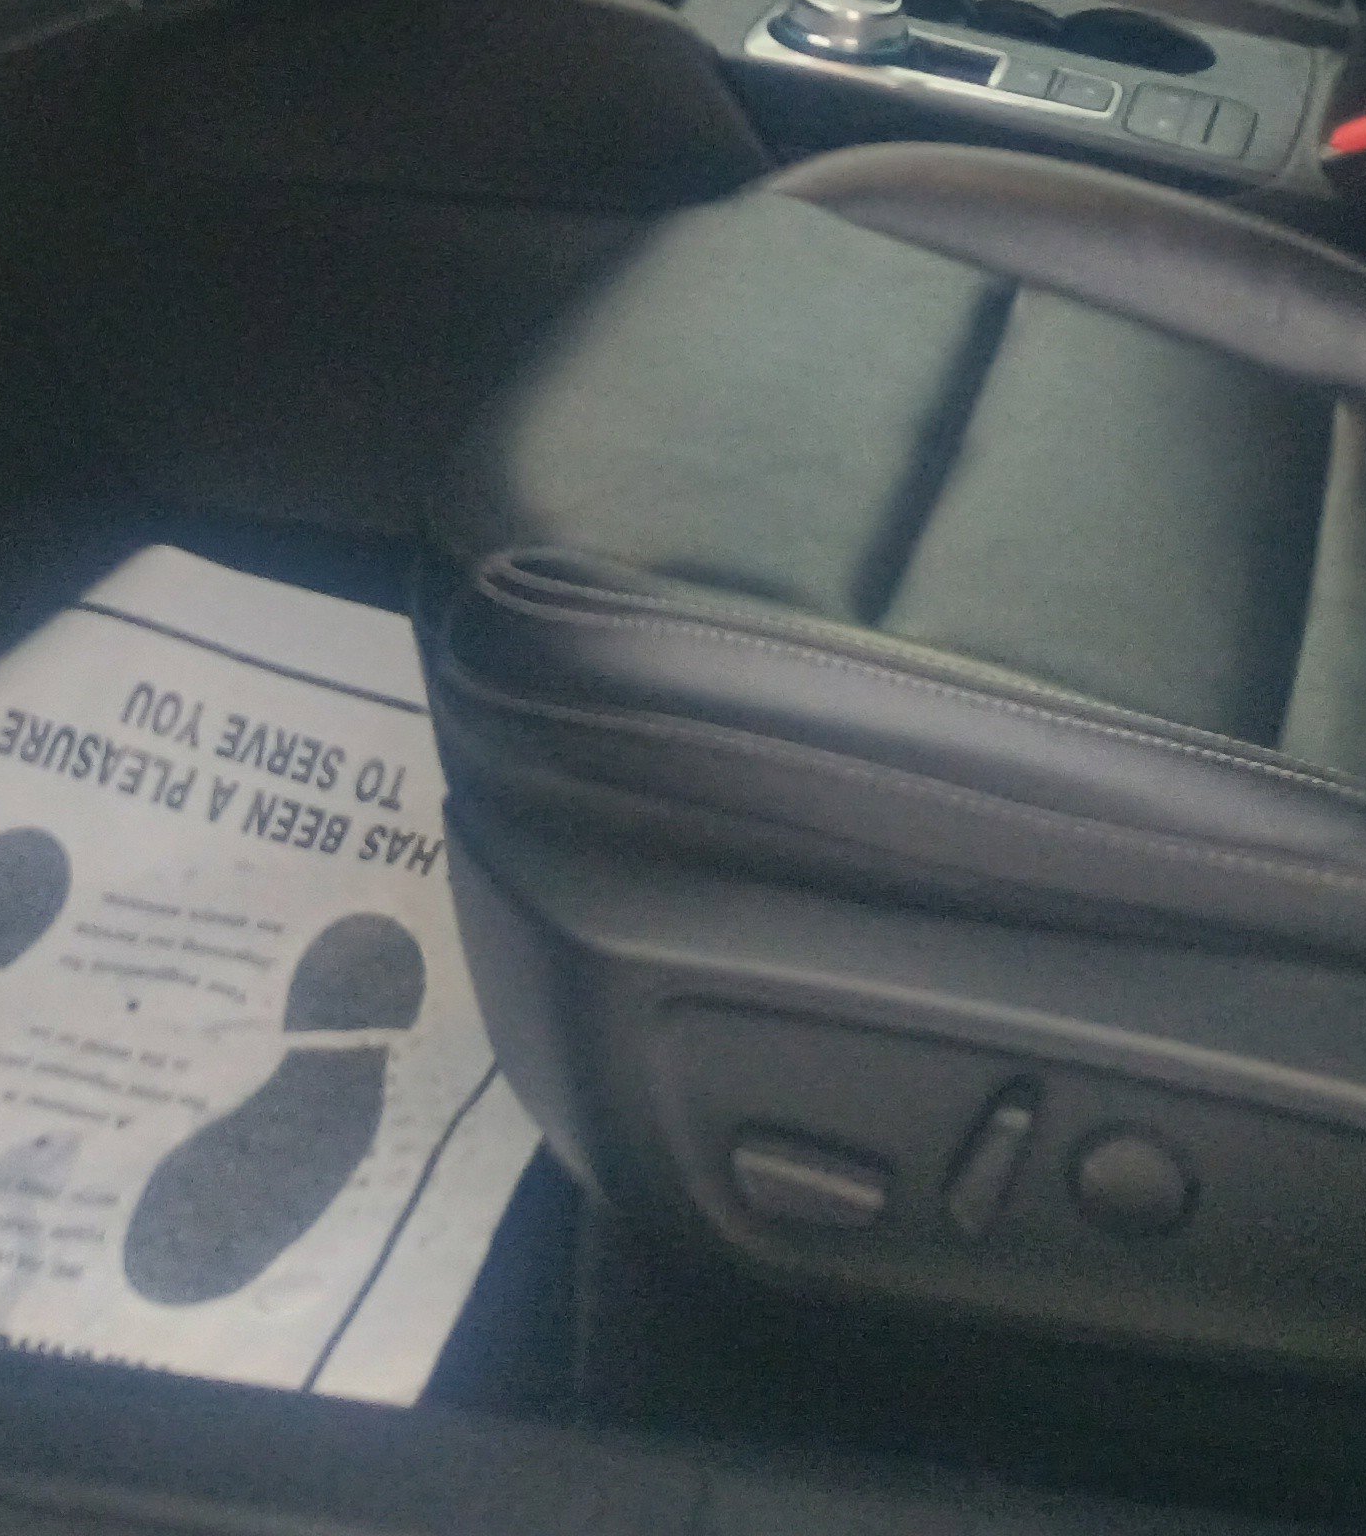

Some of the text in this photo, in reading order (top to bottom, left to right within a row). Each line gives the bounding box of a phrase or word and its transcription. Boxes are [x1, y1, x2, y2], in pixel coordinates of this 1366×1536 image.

[119, 682, 407, 813] TO SERVE YOU
[205, 776, 239, 824] A
[240, 790, 351, 855] BEEN
[358, 824, 440, 877] HAS
